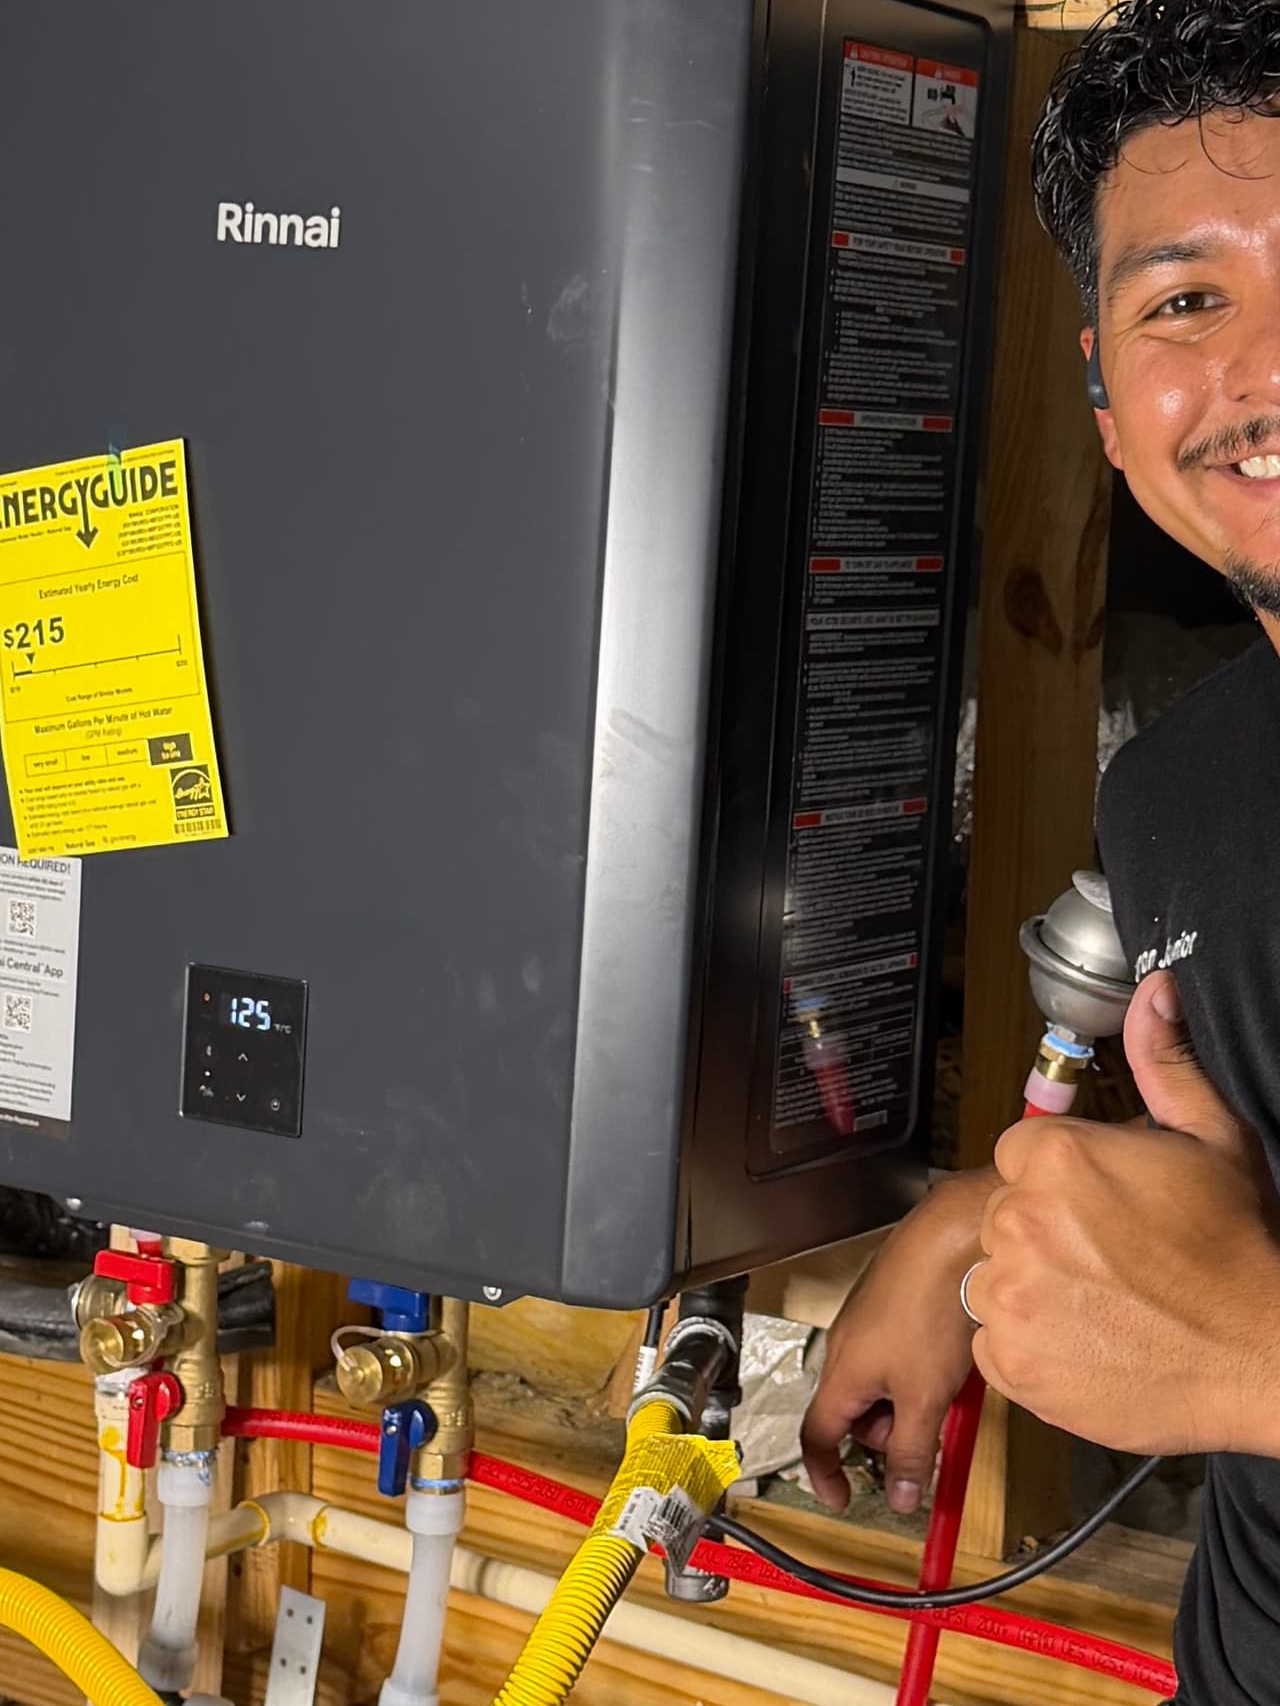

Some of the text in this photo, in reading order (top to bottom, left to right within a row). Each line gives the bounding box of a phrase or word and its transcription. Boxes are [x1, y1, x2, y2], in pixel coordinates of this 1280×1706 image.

[216, 201, 341, 249] Rinnai
[74, 581, 96, 594] Yearly
[97, 577, 121, 591] Energy
[122, 573, 139, 585] Cost
[3, 616, 65, 650] $215
[106, 712, 129, 724] Minute
[43, 964, 64, 978] App
[230, 997, 271, 1031] 125
